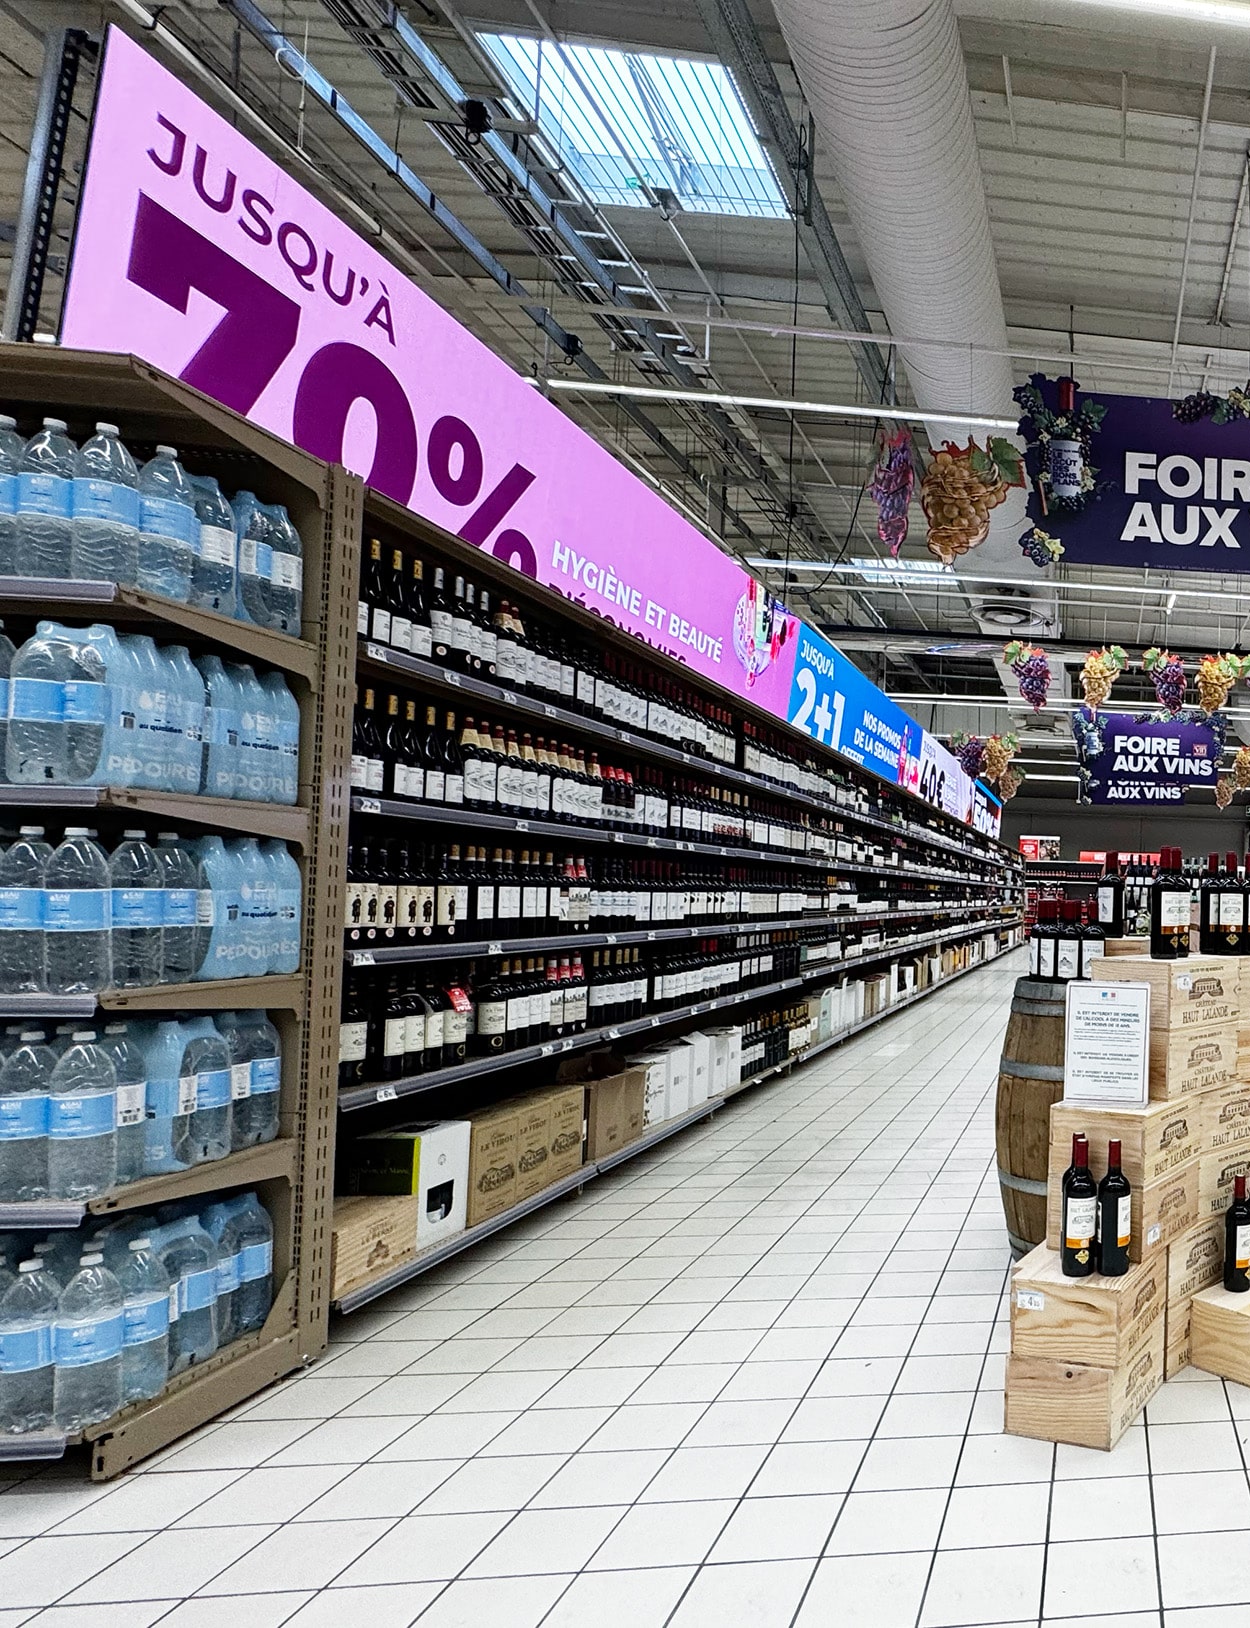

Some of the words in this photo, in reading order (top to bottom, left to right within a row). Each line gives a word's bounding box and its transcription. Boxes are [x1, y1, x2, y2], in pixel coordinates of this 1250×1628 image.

[147, 112, 396, 347] JUSQU'À
[127, 189, 536, 580] 70%
[1120, 502, 1241, 549] AUX
[552, 540, 642, 616] HYGIÈNE
[645, 600, 666, 630] ET
[668, 610, 722, 663] BEAUTÉ
[801, 640, 834, 680] JUSQU'À
[791, 668, 845, 753] 2+1
[863, 710, 877, 730] NOS
[877, 716, 901, 749] PROMOS
[854, 728, 865, 746] DE
[865, 735, 873, 754] LA
[874, 740, 899, 768] SEMAINE
[1113, 755, 1159, 772] AUX
[1162, 757, 1212, 776] VINS
[1114, 735, 1180, 756] FOIRE
[1107, 786, 1141, 799] AUX
[1143, 787, 1181, 799] VINS
[1213, 1134, 1230, 1147] HAUT
